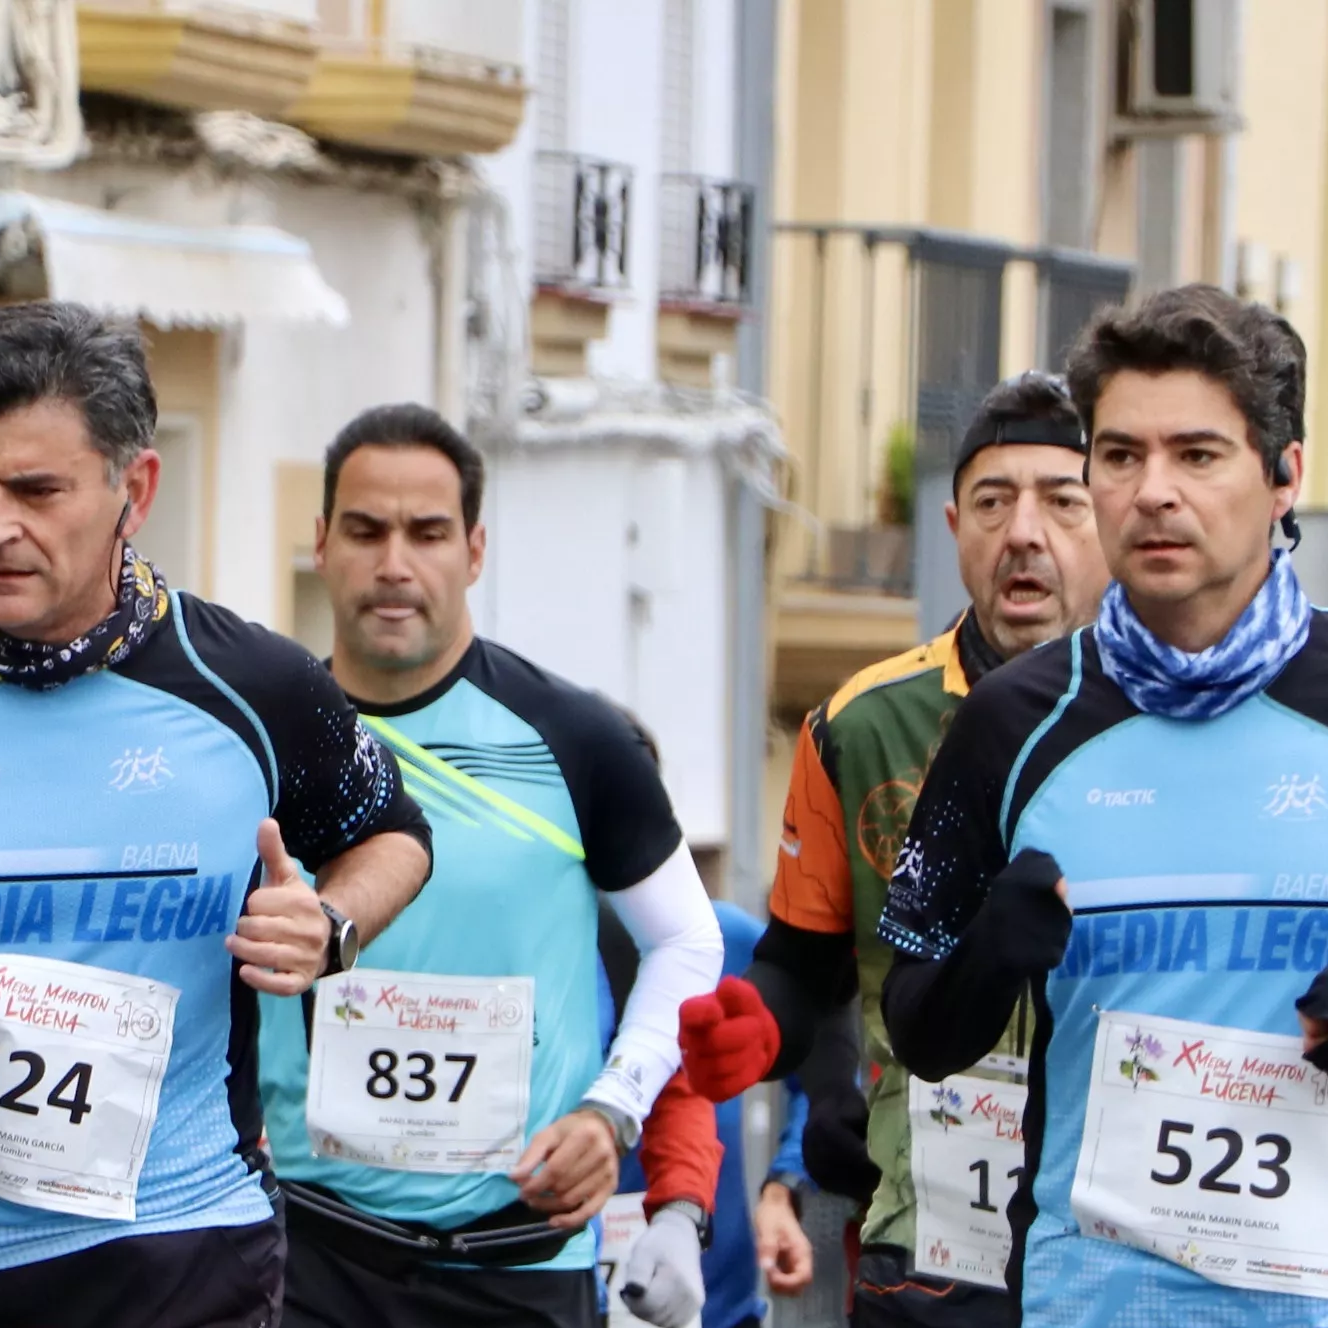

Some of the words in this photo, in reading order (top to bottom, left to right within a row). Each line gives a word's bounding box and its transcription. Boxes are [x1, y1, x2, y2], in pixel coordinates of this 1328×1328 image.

[1103, 787, 1157, 807] TACTIC
[122, 841, 199, 870] BAENA
[71, 873, 233, 943] LEGUA
[4, 996, 90, 1035] LUCENA
[398, 1011, 465, 1033] LUCENA
[366, 1047, 478, 1104] 837
[1200, 1071, 1288, 1108] LUCENA
[1149, 1119, 1293, 1200] 523
[1208, 1213, 1243, 1228] MARIN
